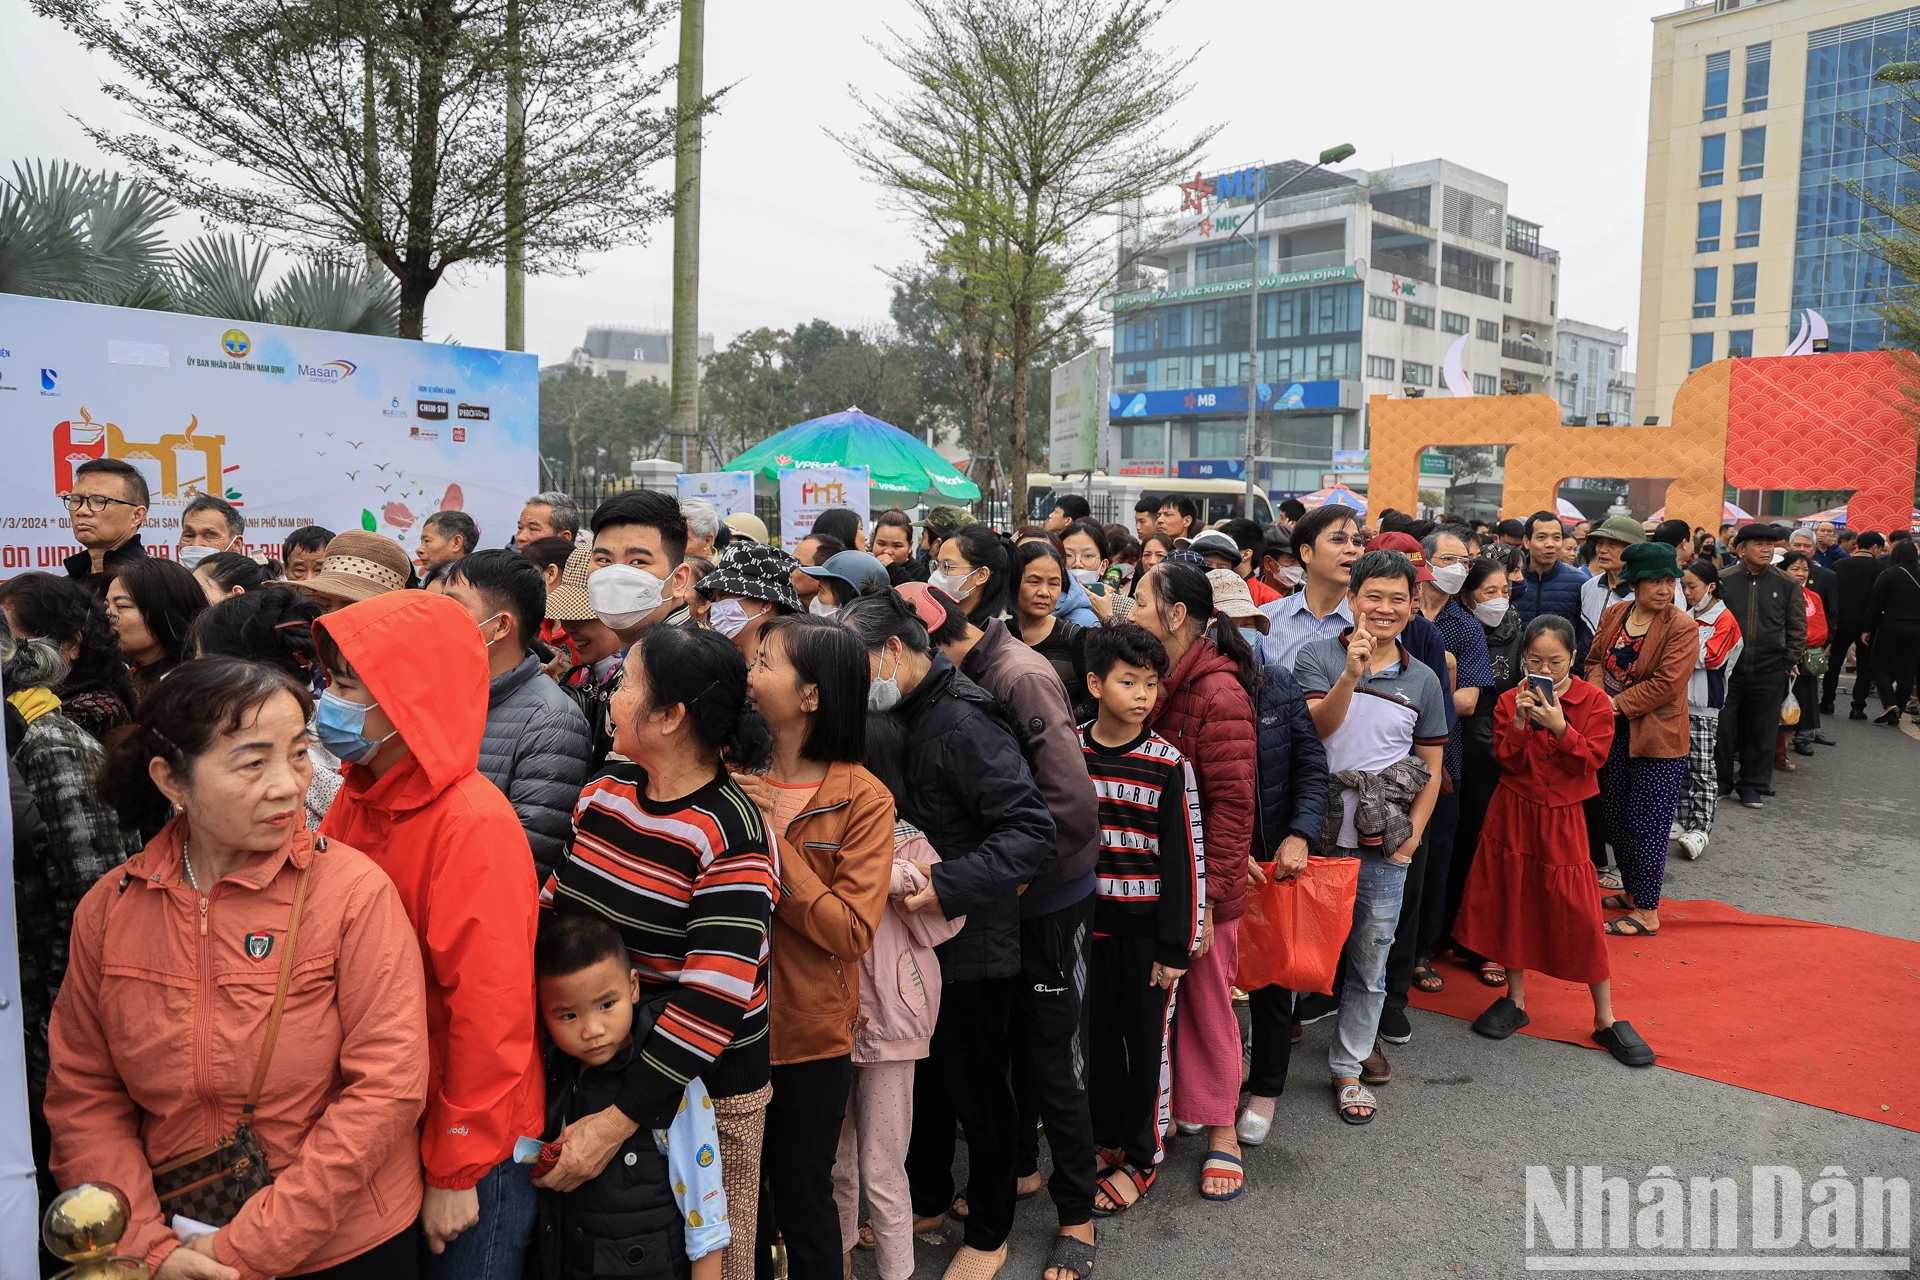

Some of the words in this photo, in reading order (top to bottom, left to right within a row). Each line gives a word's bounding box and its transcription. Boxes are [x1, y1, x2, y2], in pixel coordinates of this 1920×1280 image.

[1217, 167, 1265, 203] MB
[1216, 215, 1241, 232] MIC
[1258, 279, 1276, 288] VỤ
[1280, 274, 1310, 284] NAM
[1313, 269, 1346, 281] ĐỊNH
[196, 359, 209, 368] BAN
[210, 359, 227, 369] NHÂN
[228, 360, 241, 370] DÂN
[256, 364, 270, 373] NAM
[270, 366, 285, 374] ĐỊNH
[298, 364, 338, 378] Masan
[309, 376, 338, 384] consumer
[1197, 394, 1217, 407] MB
[794, 460, 840, 469] VPBank
[1200, 465, 1213, 475] MB
[878, 482, 910, 492] VPBank
[58, 517, 73, 529] QU
[162, 517, 179, 530] SẠN
[243, 515, 260, 528] ÀNH
[261, 514, 277, 528] PHỐ
[278, 518, 295, 528] NAM
[0, 544, 31, 568] ÔN
[447, 1125, 469, 1136] yody
